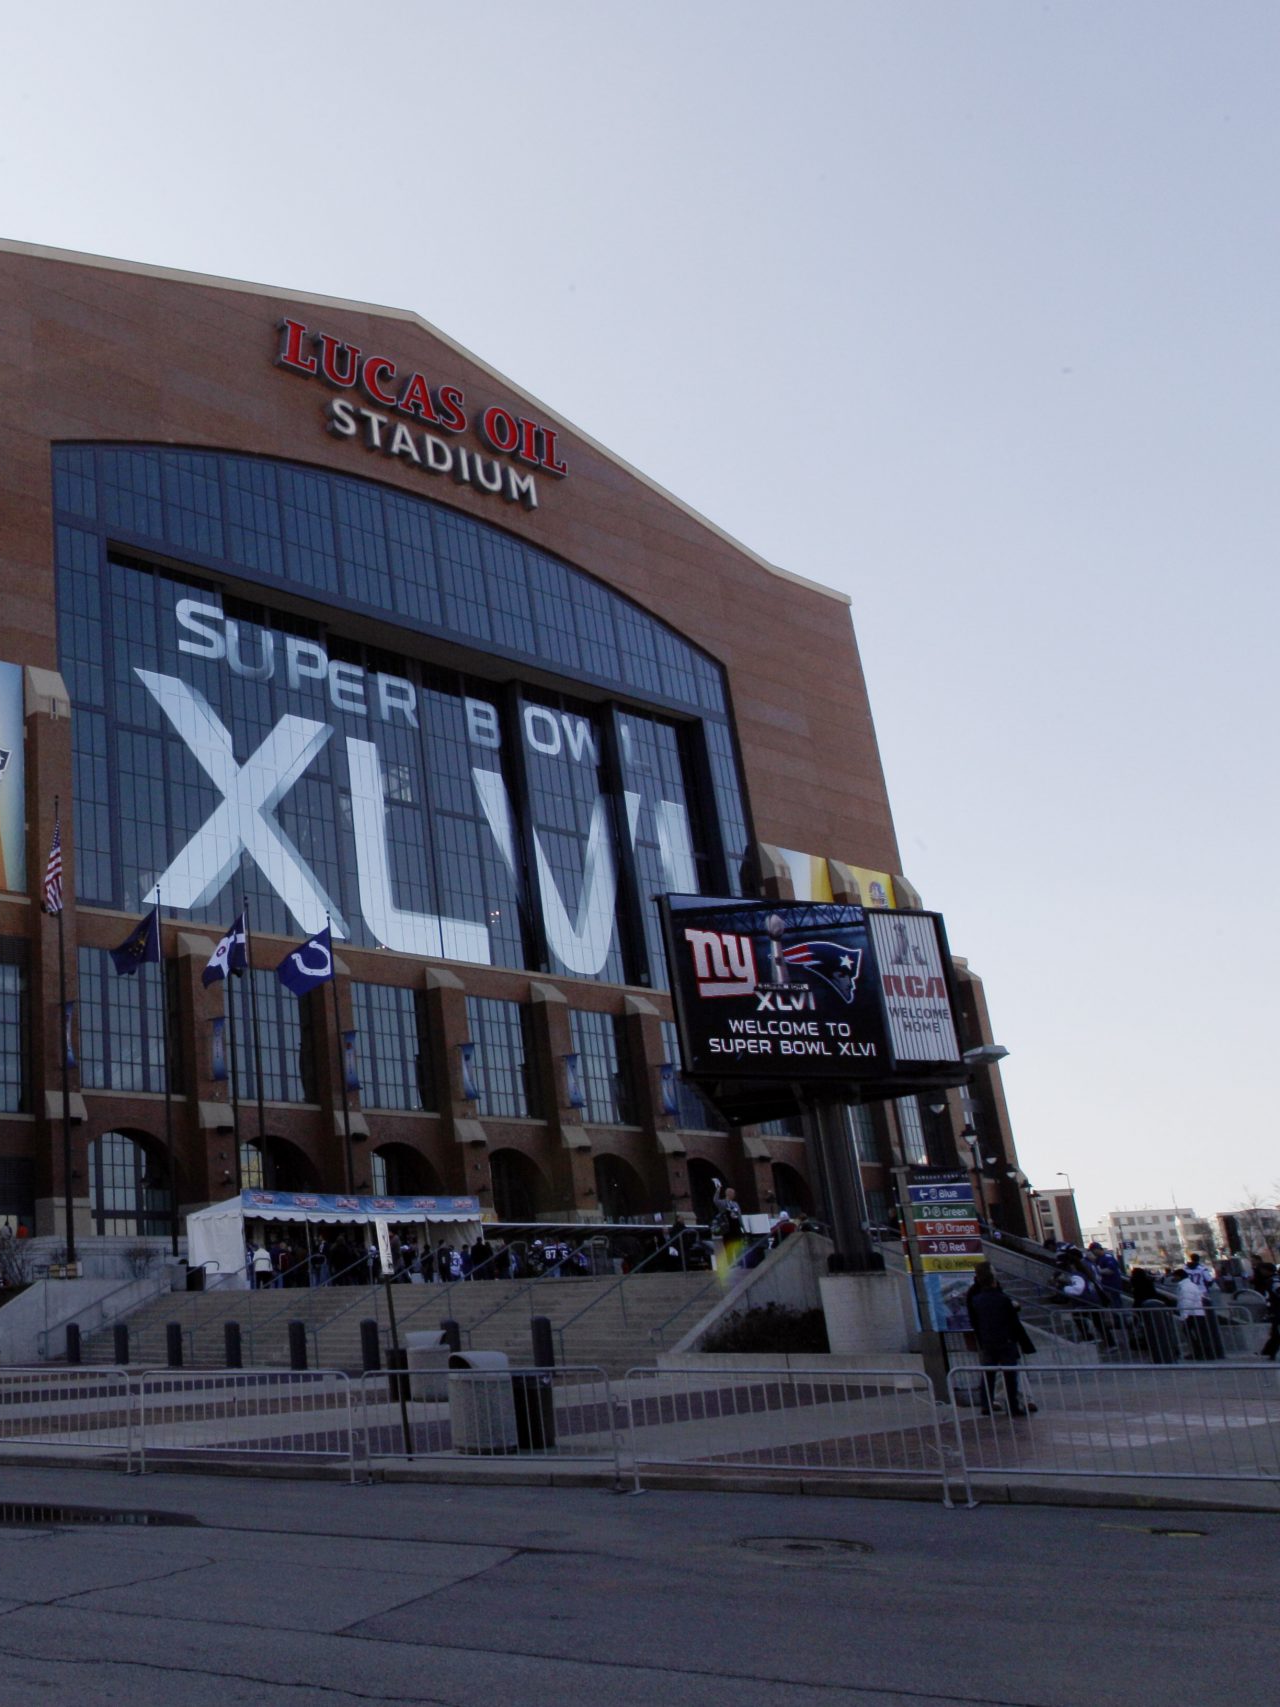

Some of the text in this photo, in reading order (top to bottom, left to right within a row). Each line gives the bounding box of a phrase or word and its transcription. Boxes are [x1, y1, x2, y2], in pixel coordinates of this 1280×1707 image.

[276, 317, 569, 477] LUCAS OIL
[328, 397, 538, 509] STADIUM
[175, 598, 651, 771] SUPER BOWL
[133, 667, 699, 976] XLVI
[881, 974, 946, 999] RCA
[755, 990, 816, 1012] XLVI
[888, 1006, 950, 1021] WELCOME
[728, 1019, 851, 1038] WELCOME TO
[904, 1020, 941, 1034] HOME
[708, 1038, 877, 1058] SUPER BOWL XLVI
[938, 1189, 959, 1199] Blue
[941, 1206, 969, 1217] Green
[945, 1224, 976, 1234] Orange
[949, 1242, 967, 1252] Red
